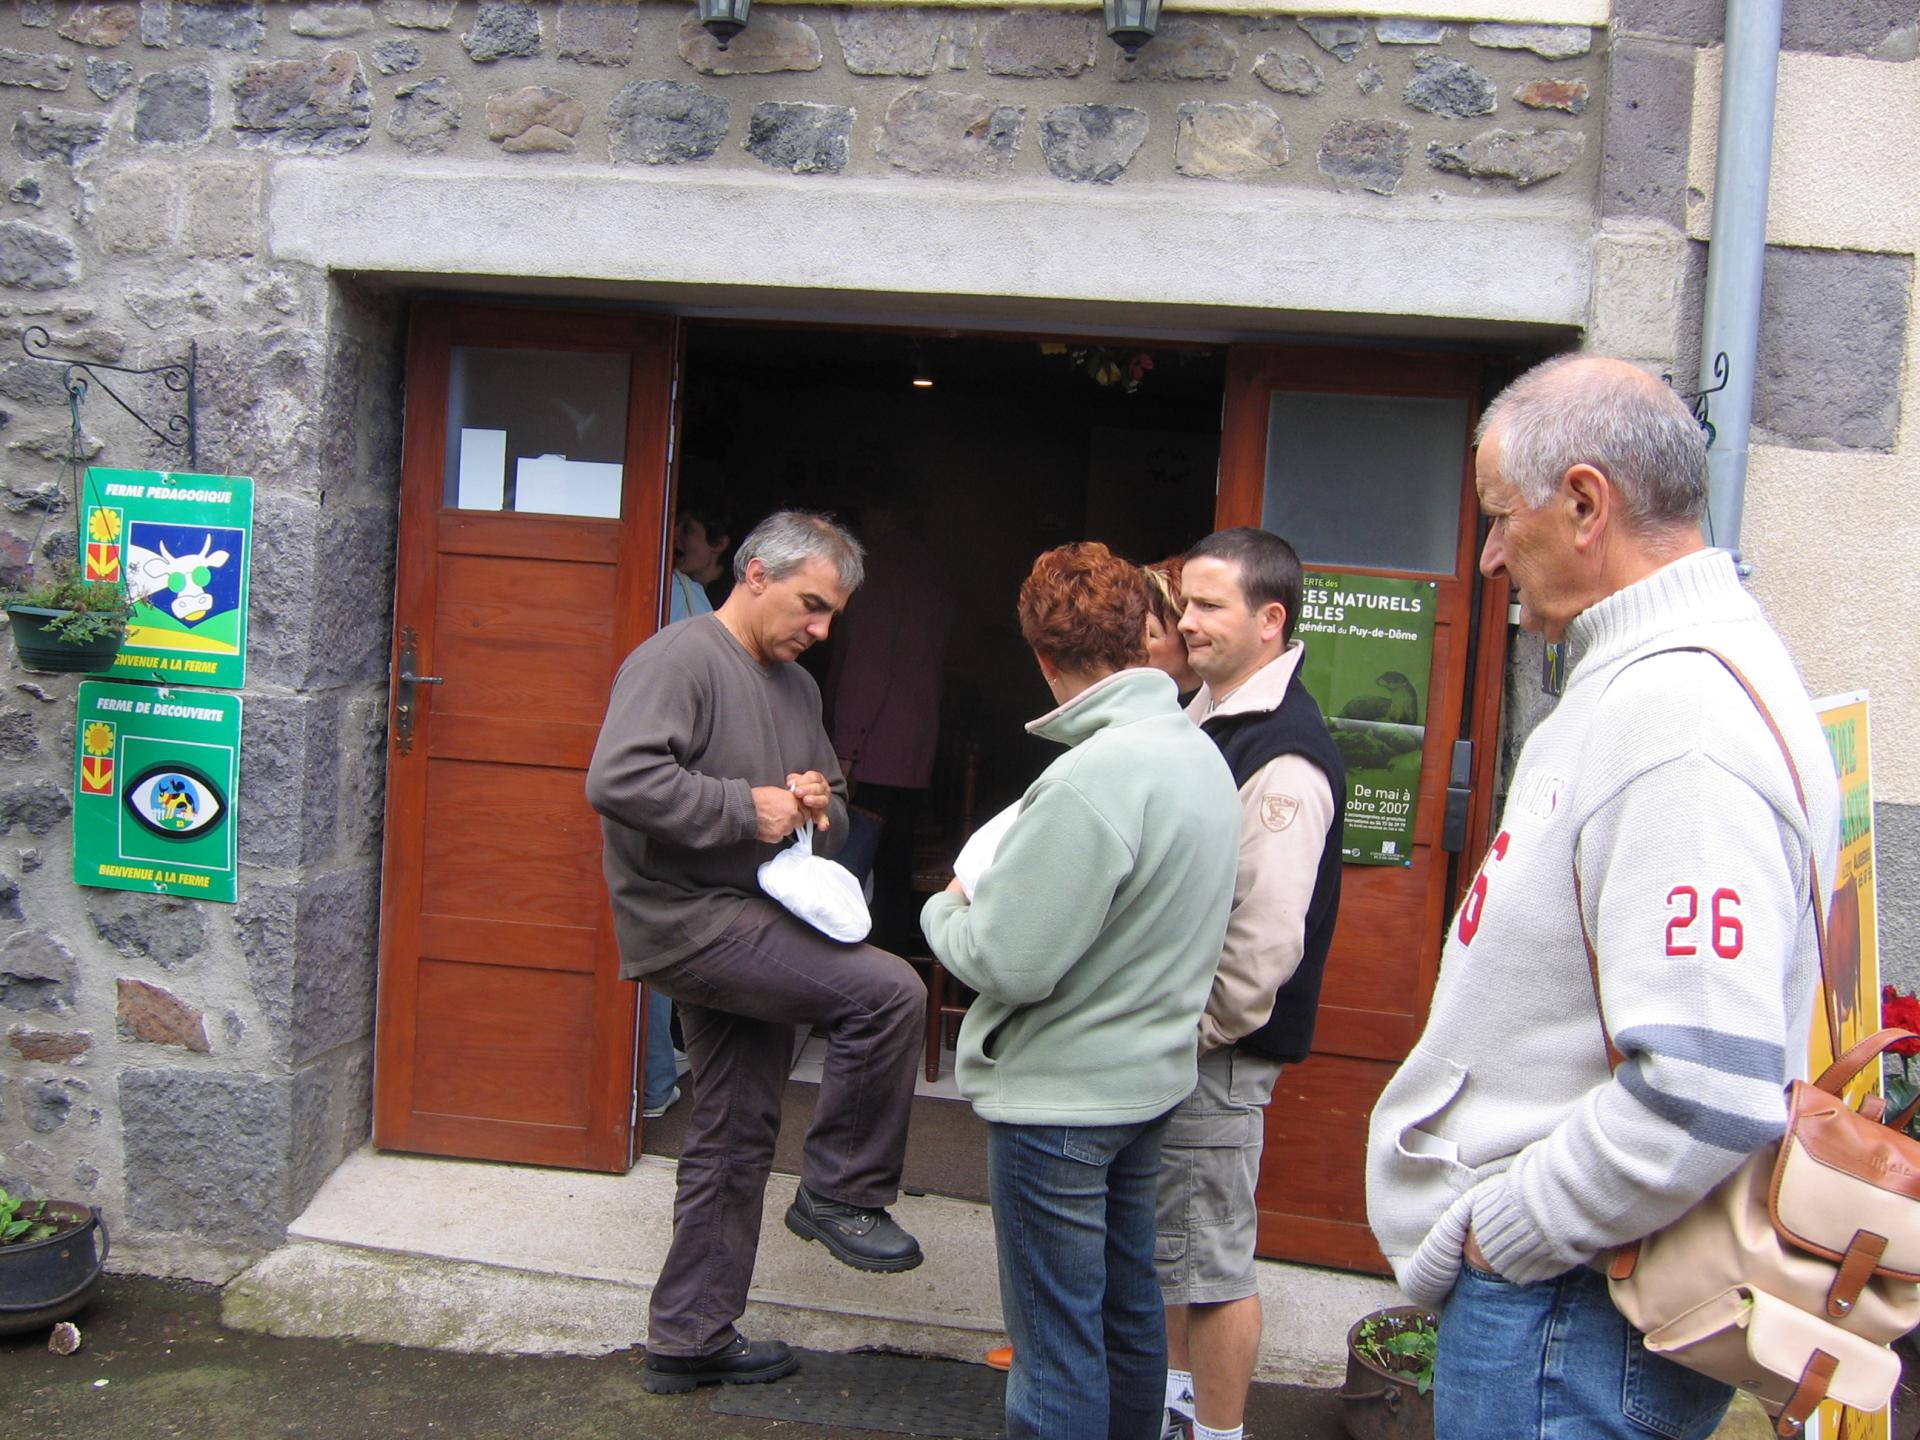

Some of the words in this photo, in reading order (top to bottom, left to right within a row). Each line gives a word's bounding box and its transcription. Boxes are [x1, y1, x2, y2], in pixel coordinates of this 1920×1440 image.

[105, 483, 144, 498] FERME
[146, 486, 232, 504] PEDAGOGIQUE
[1304, 577, 1324, 587] ERTE
[1325, 580, 1338, 588] des
[1303, 589, 1328, 604] ES
[1333, 591, 1421, 613] NATURELS
[1302, 604, 1344, 621] BLES
[1299, 621, 1336, 633] général
[1349, 625, 1418, 641] Puy-de-Dôme
[114, 653, 160, 668] ENVENUE
[160, 657, 168, 669] A
[170, 658, 182, 671] LA
[184, 660, 218, 674] FERME
[97, 697, 132, 713] FERME
[135, 700, 151, 714] DE
[153, 702, 224, 722] DECOUVERTE
[1355, 784, 1371, 797] De
[1375, 788, 1399, 800] mai
[1402, 788, 1410, 801] à
[1346, 799, 1375, 812] obre
[1379, 800, 1410, 815] 2007
[98, 864, 154, 881] BIENVENUE
[154, 869, 163, 881] A
[165, 871, 177, 884] LA
[178, 873, 210, 888] FERME
[1665, 885, 1744, 960] 26
